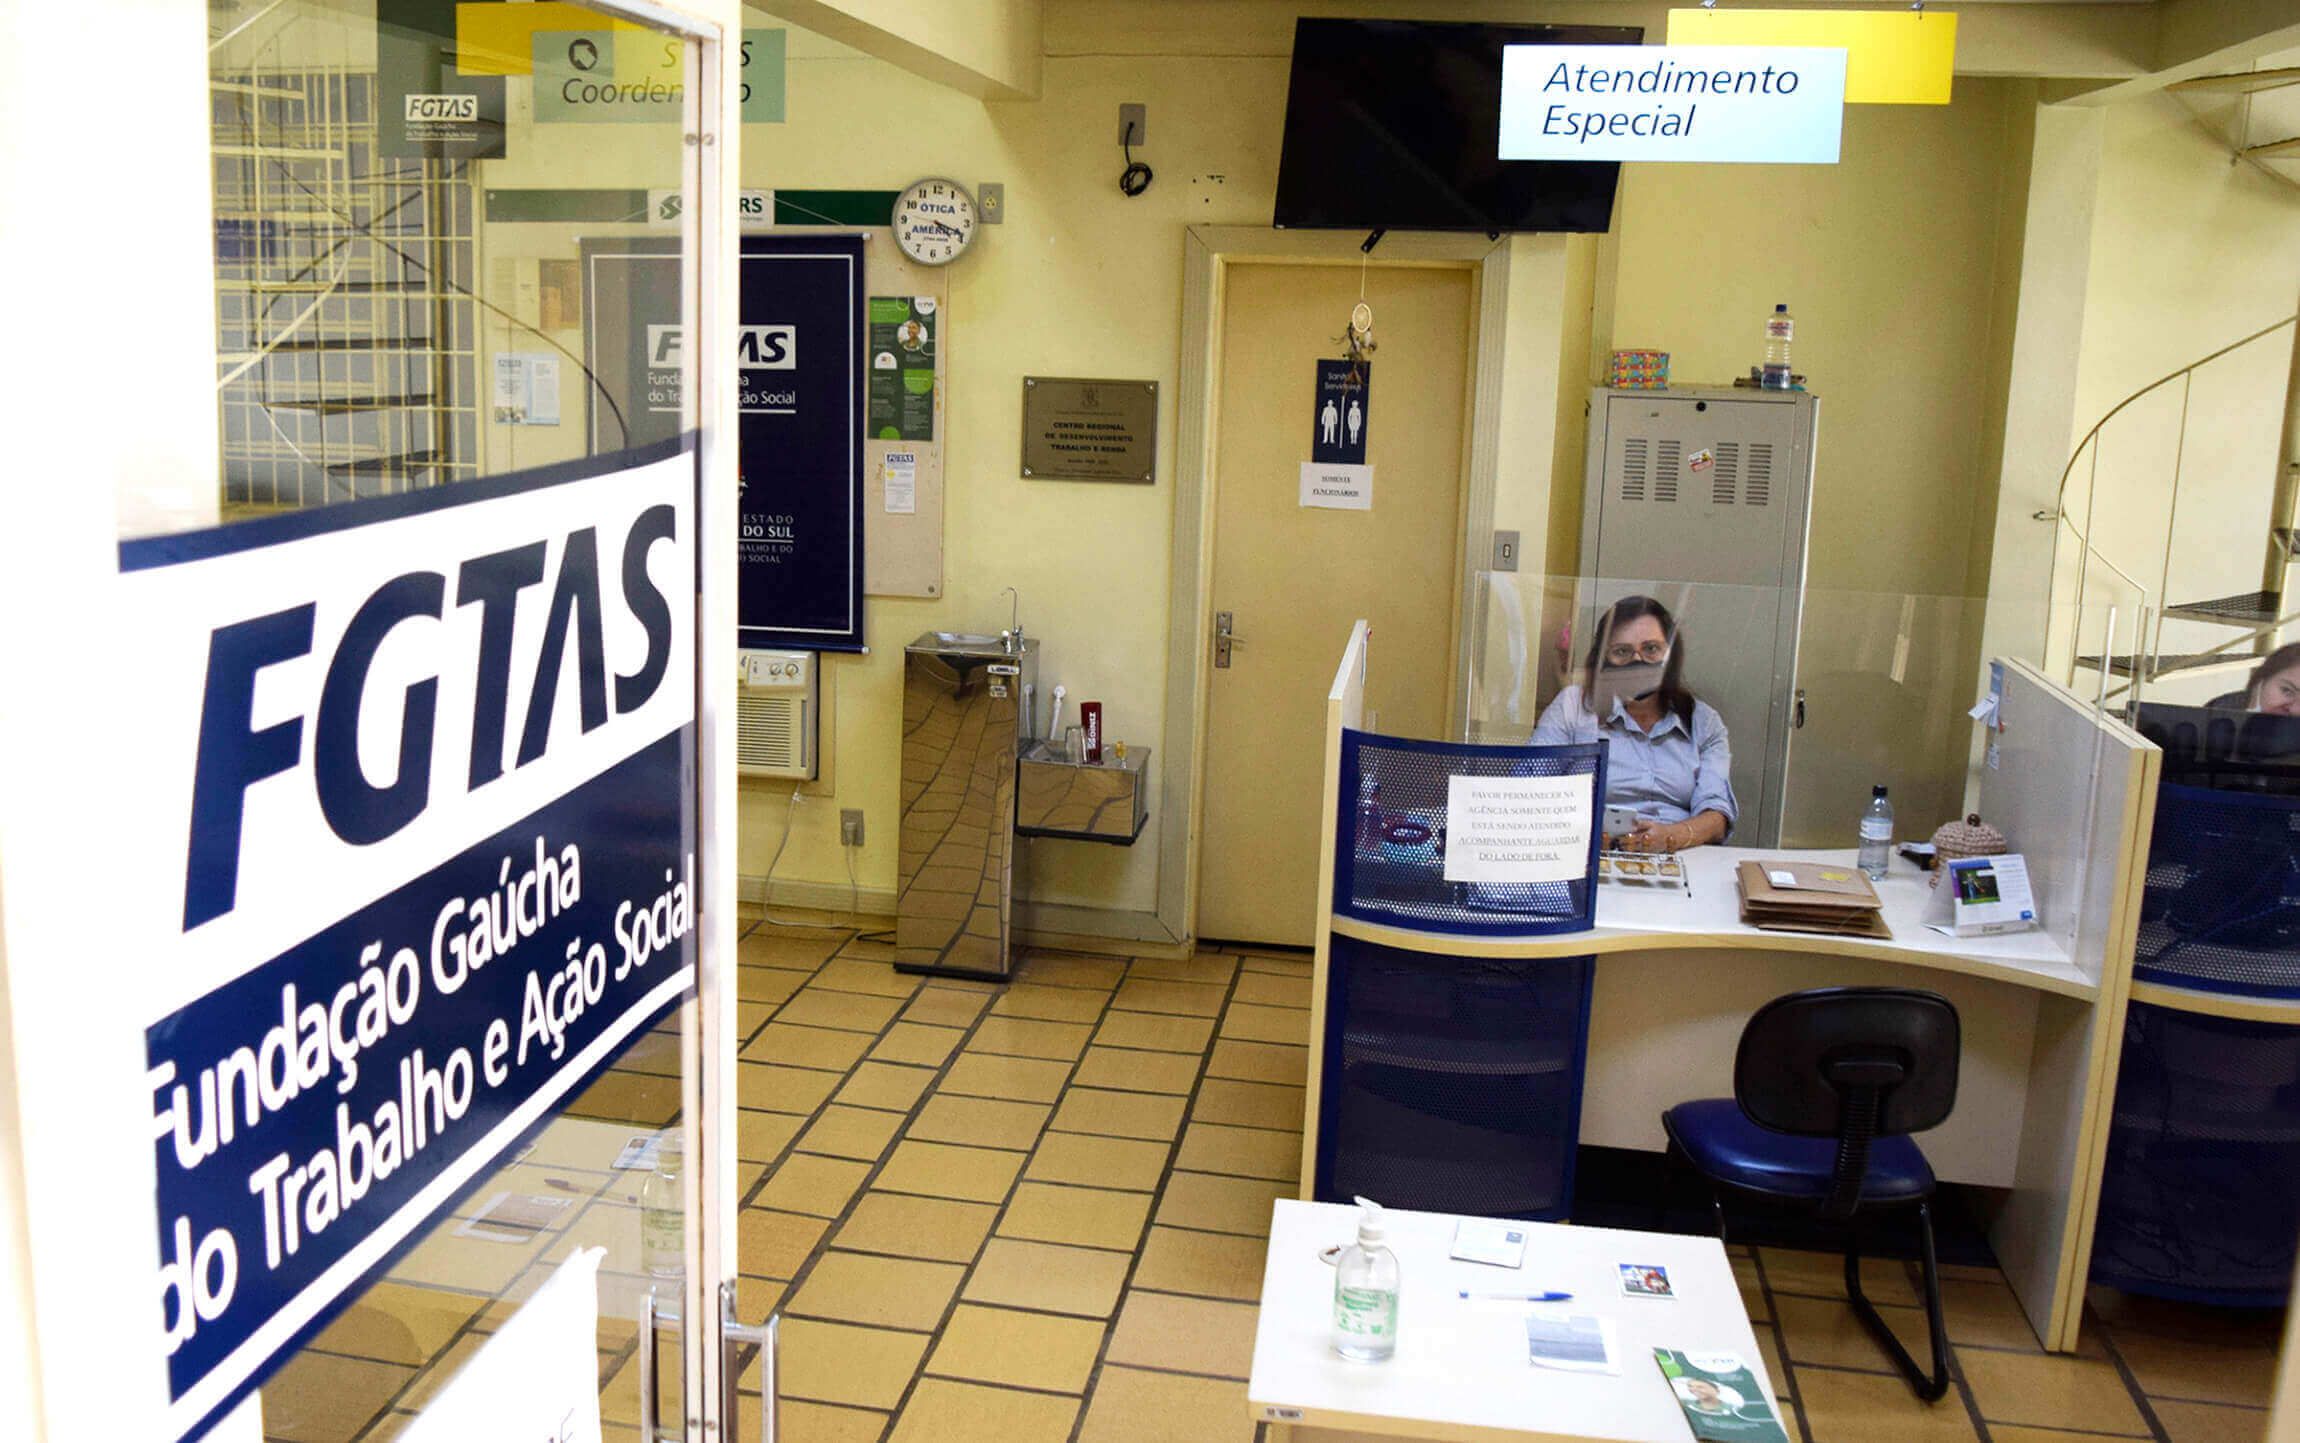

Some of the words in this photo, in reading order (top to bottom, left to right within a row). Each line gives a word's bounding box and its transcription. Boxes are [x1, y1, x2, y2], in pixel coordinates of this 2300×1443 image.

[1542, 60, 1800, 95] Atendimento
[408, 97, 475, 118] FGTAS
[1543, 103, 1697, 144] Especial
[648, 389, 665, 402] do
[761, 390, 796, 405] Social
[743, 514, 794, 525] ESTADO
[743, 525, 764, 537] DO
[768, 526, 794, 538] SUL
[182, 504, 675, 934] FGTAS
[1510, 807, 1552, 815] SOMENTE
[146, 940, 420, 1170] Fundação
[430, 836, 581, 994] Gaúcha
[160, 1216, 238, 1357] do
[249, 1047, 473, 1271] Trabalho
[482, 1018, 511, 1087] e
[518, 936, 607, 1066] Ação
[614, 853, 695, 982] Social
